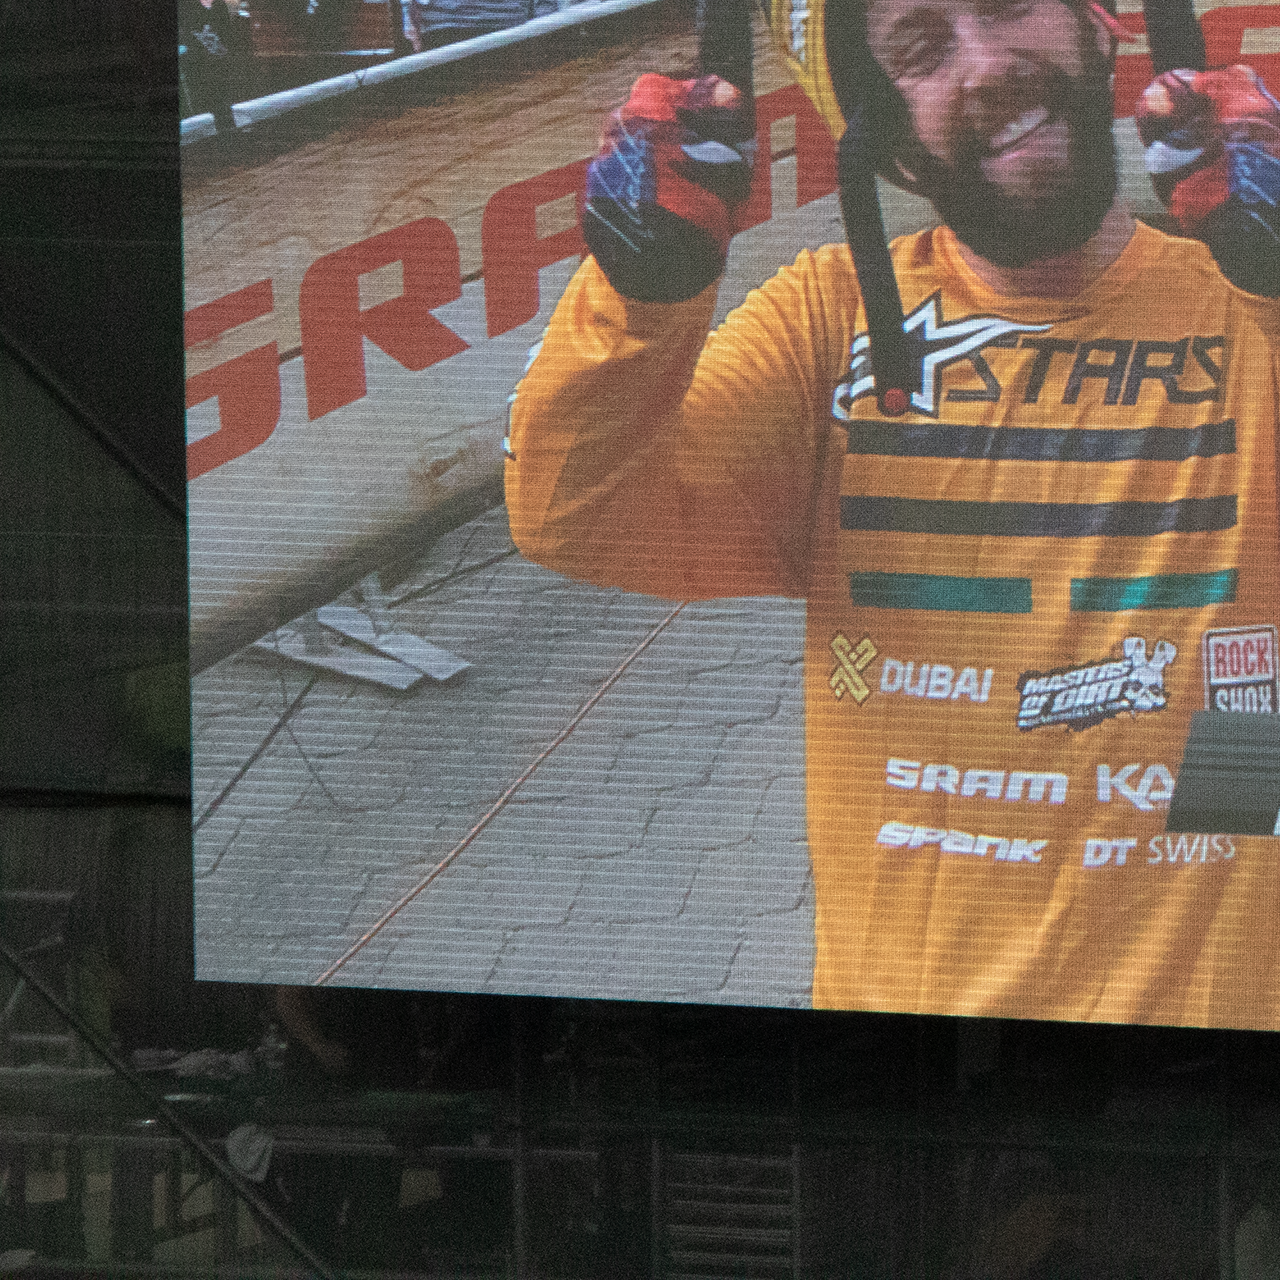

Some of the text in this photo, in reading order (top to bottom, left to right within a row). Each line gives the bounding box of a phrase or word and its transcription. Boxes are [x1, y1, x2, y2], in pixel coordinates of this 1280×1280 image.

[945, 335, 1226, 407] STARS
[1214, 636, 1271, 678] ROCK
[880, 658, 995, 703] DUBAI
[886, 757, 1176, 812] SRAM KA
[1083, 838, 1138, 868] DT
[1148, 833, 1236, 865] SWISS
